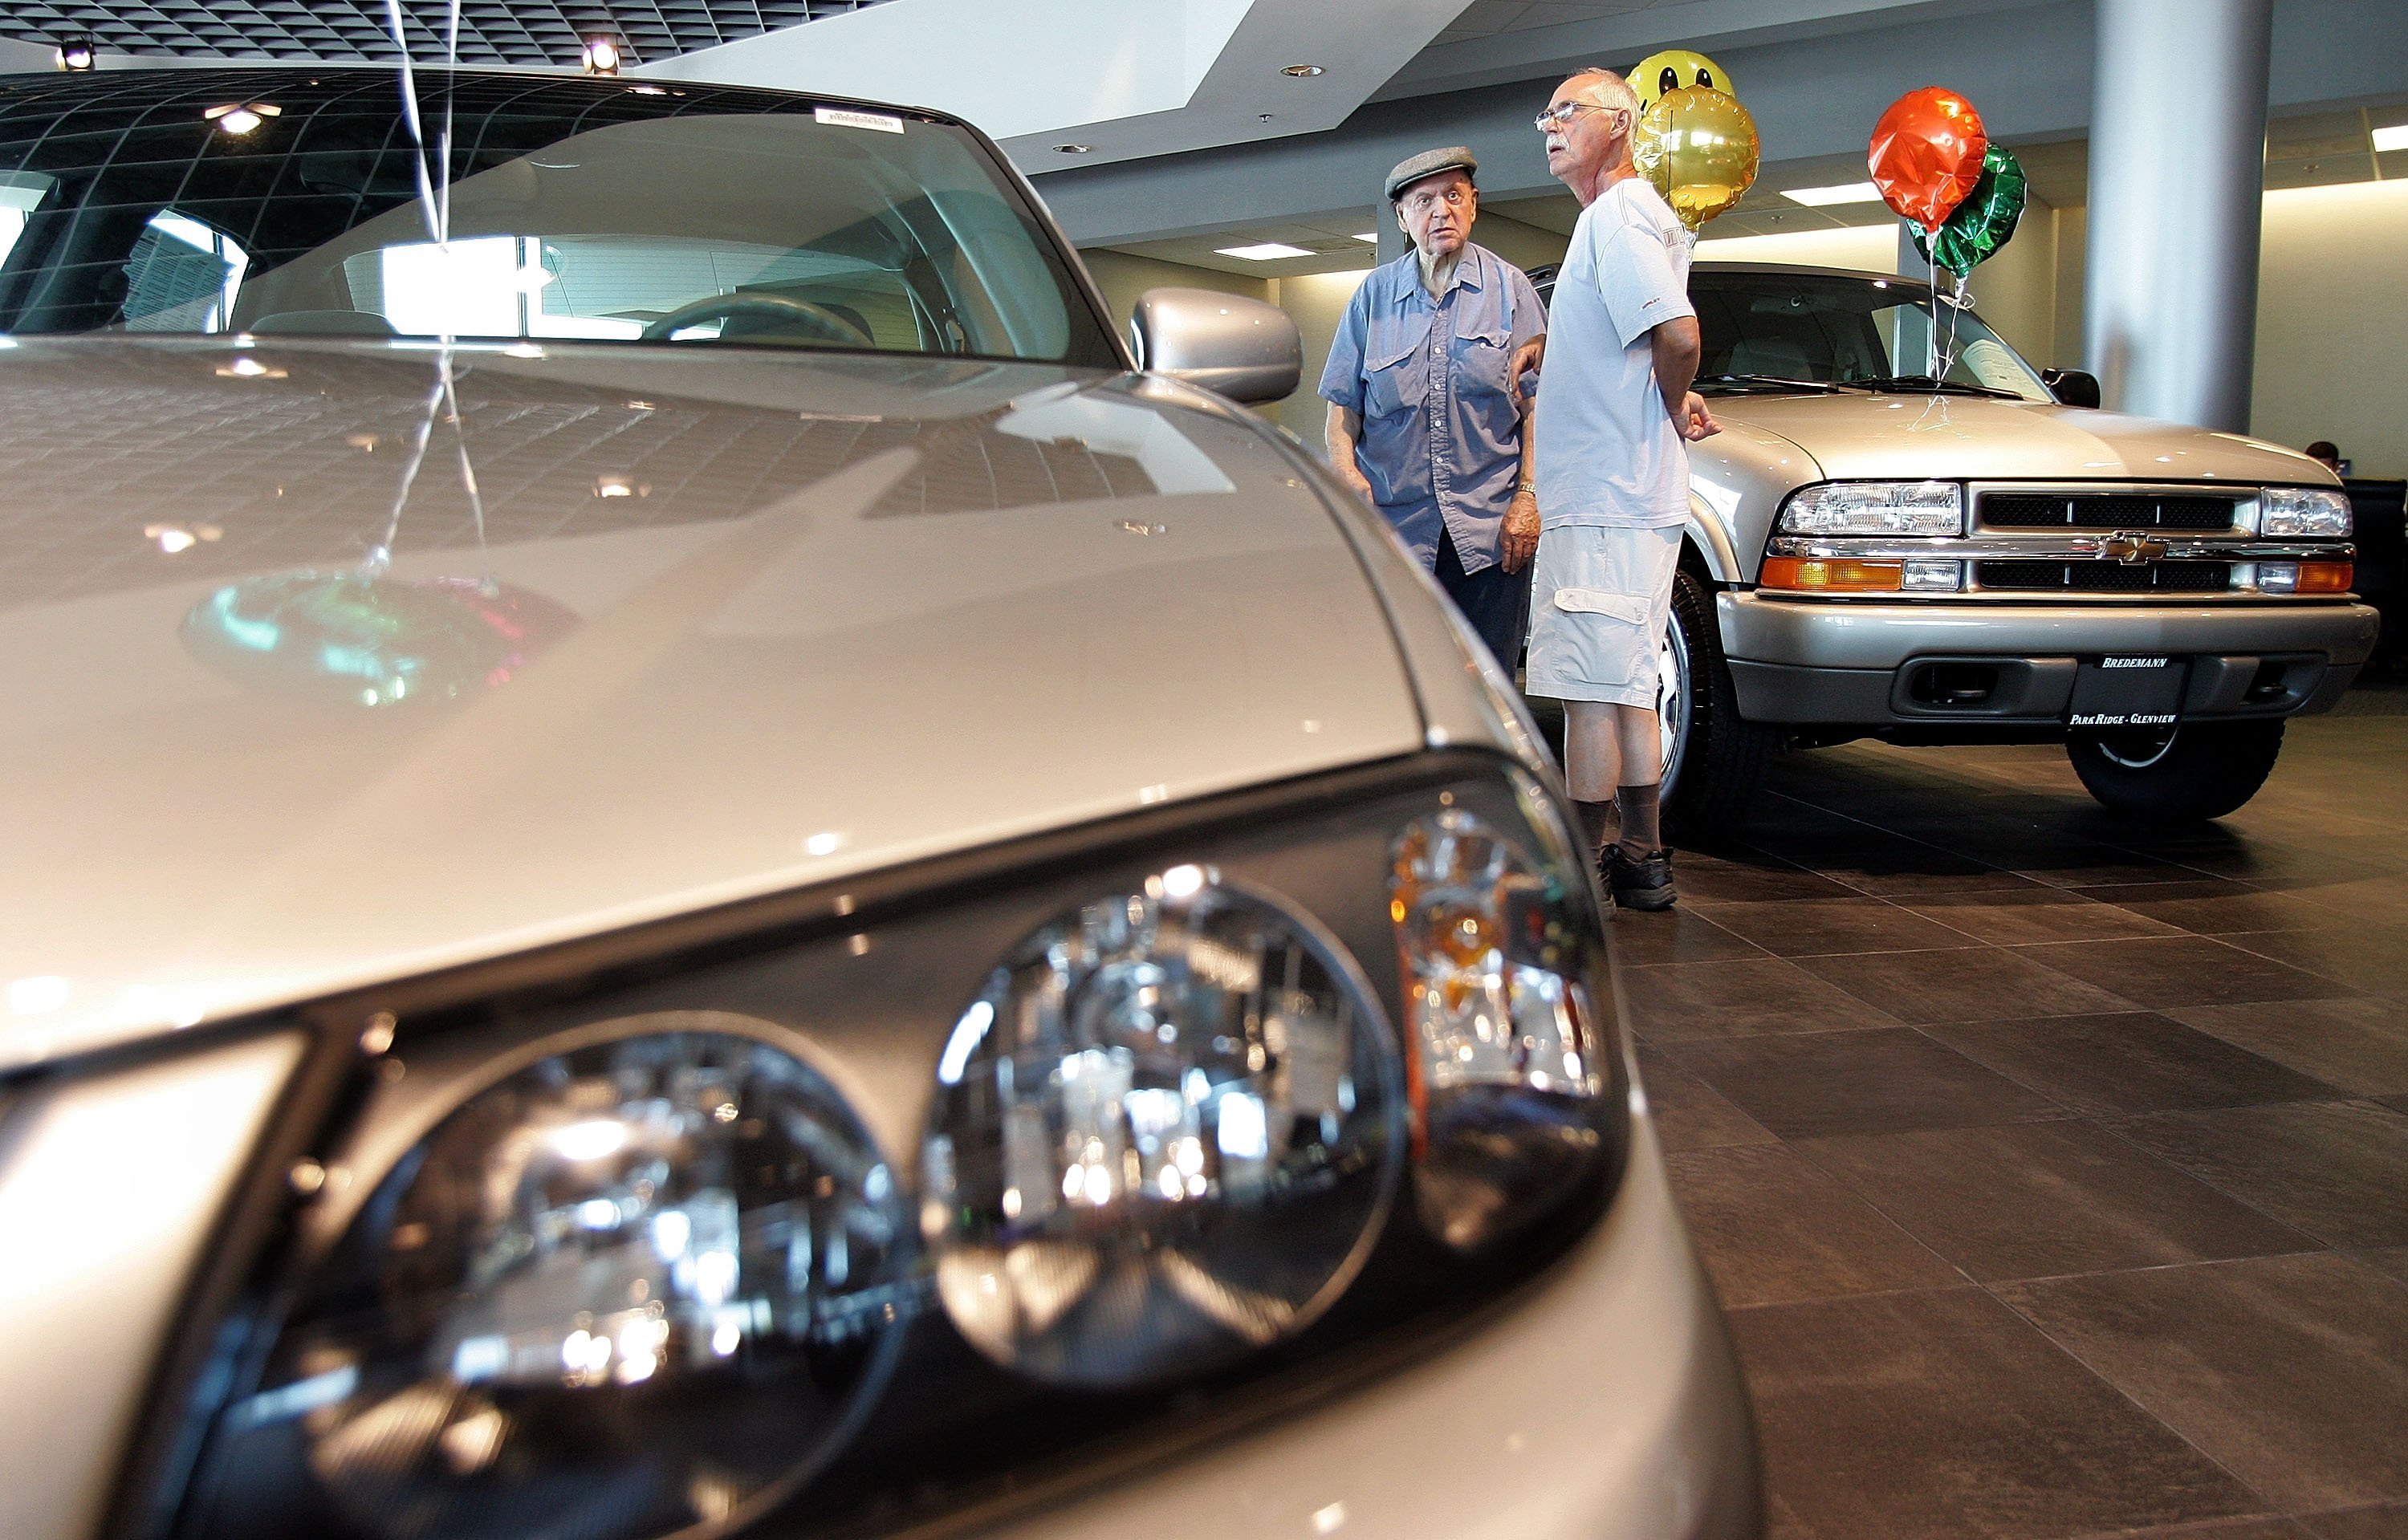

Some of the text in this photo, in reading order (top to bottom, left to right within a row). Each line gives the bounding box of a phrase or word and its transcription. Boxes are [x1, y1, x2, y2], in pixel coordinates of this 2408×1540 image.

[2102, 658, 2167, 668] BREDEMANN
[2069, 714, 2096, 725] PARK
[2095, 713, 2125, 725] RIDGE
[2130, 713, 2176, 724] GLENVIEW
